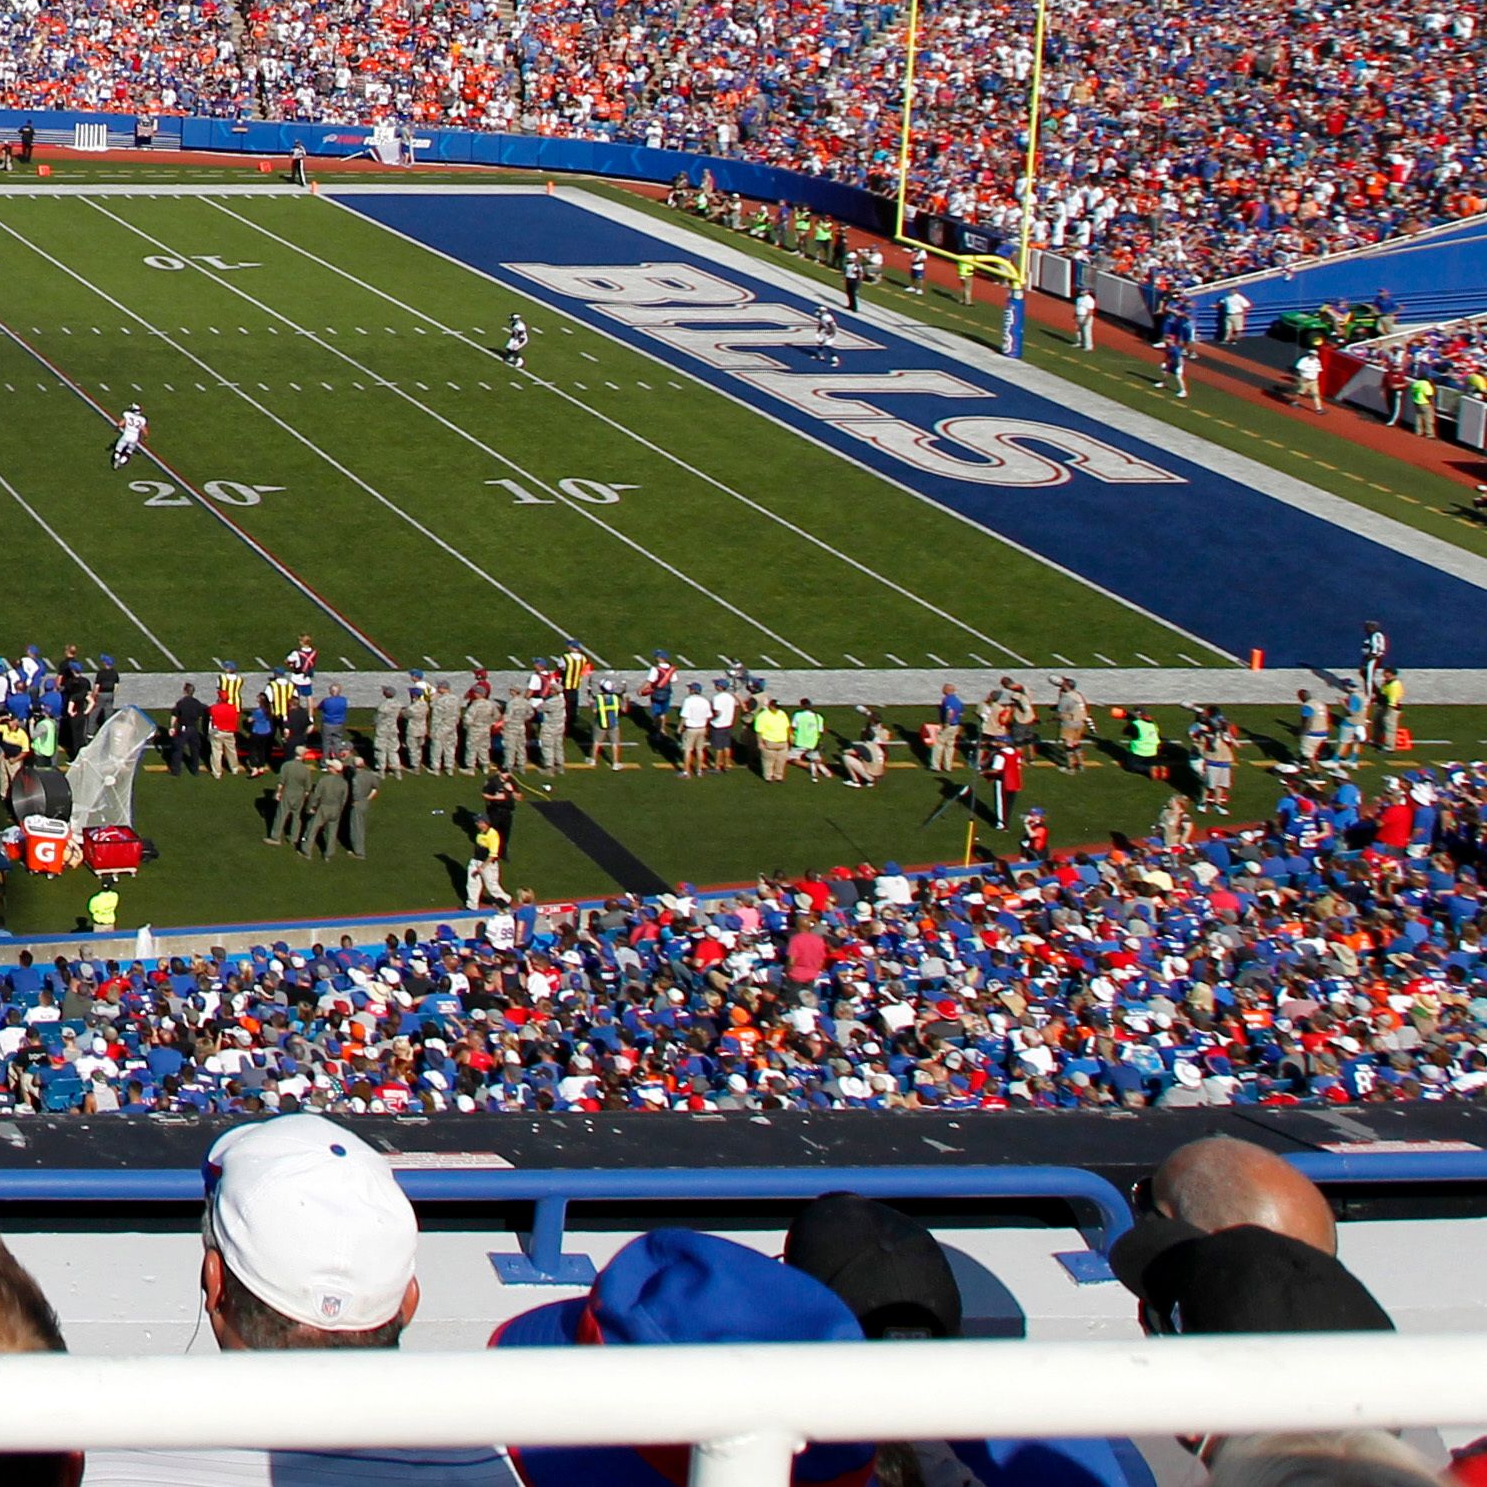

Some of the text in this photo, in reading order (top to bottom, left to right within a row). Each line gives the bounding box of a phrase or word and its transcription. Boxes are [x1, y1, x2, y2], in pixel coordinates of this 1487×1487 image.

[499, 261, 1190, 488] BILLS
[127, 416, 142, 429] 32
[128, 479, 262, 508] 20
[483, 477, 621, 505] 10
[35, 841, 57, 863] G
